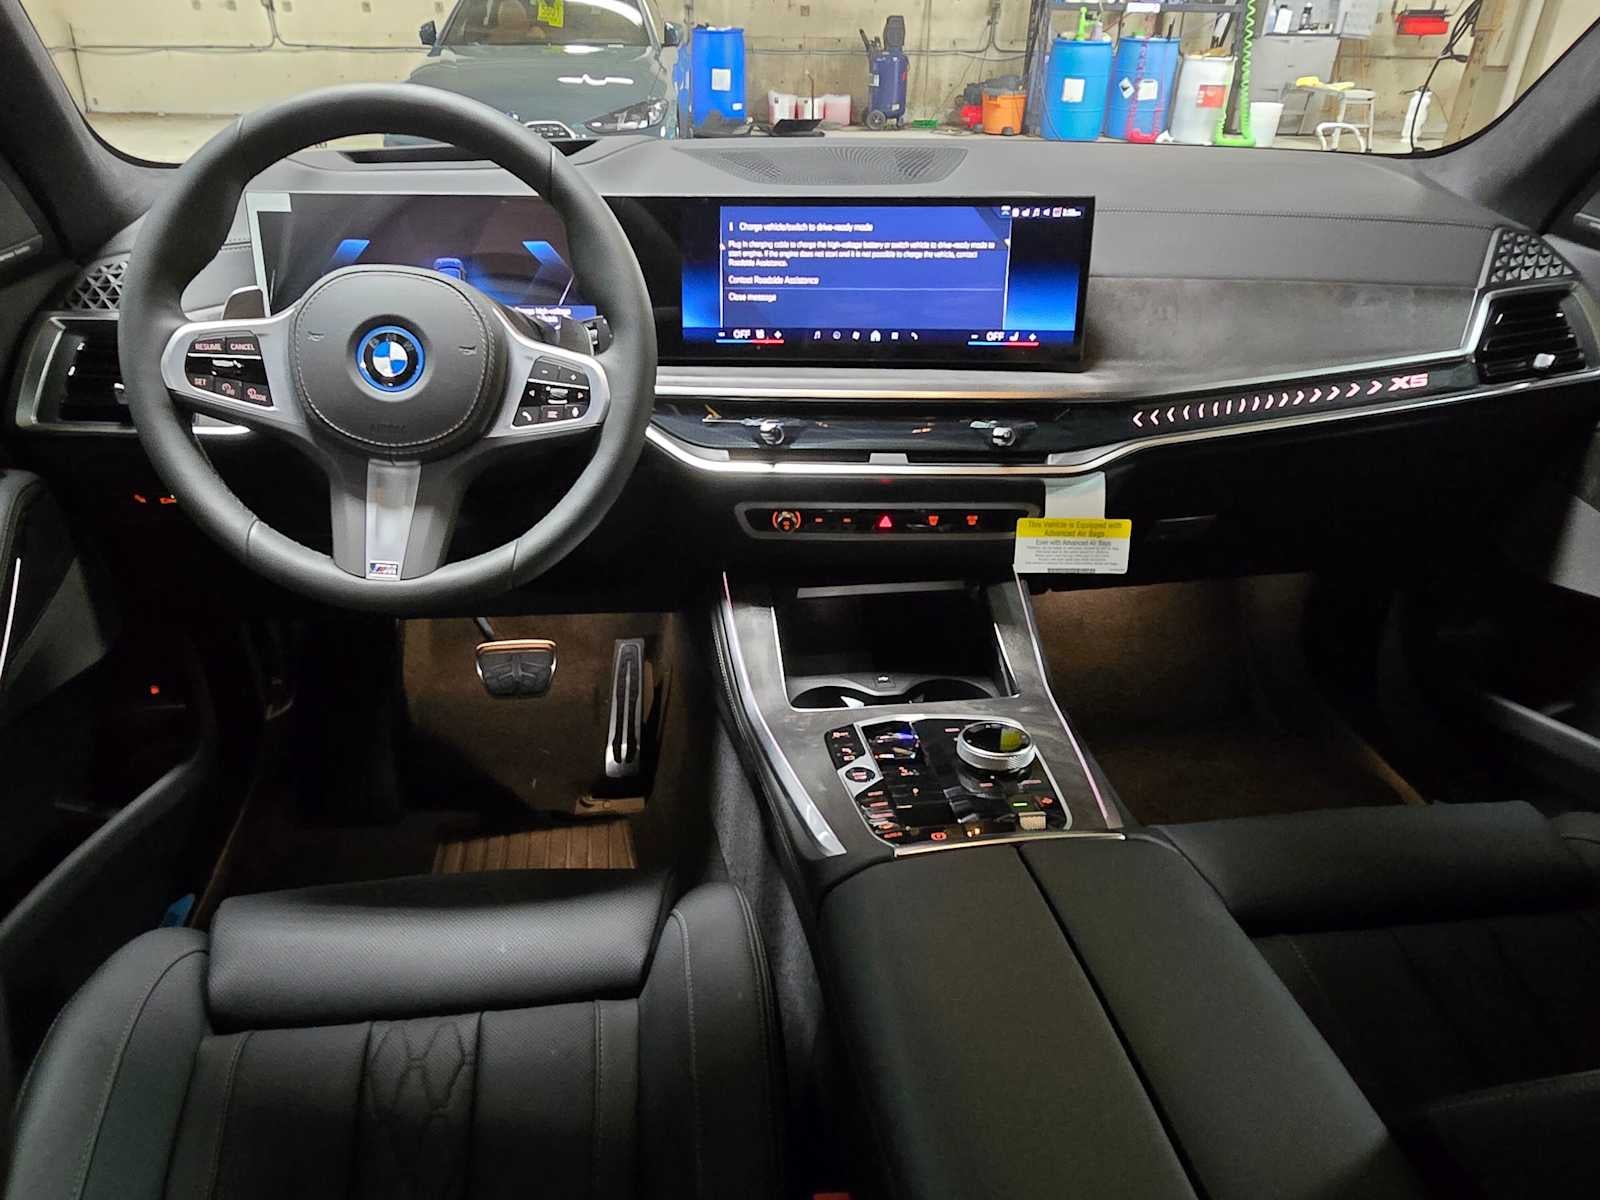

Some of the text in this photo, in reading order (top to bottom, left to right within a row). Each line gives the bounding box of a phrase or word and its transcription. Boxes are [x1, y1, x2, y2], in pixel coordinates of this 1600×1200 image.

[739, 222, 762, 232] Charge
[728, 276, 819, 285] Contact Roadside Assistance
[728, 292, 776, 302] Close message
[733, 330, 750, 338] OFF
[986, 331, 1004, 340] OFF
[1388, 373, 1428, 391] X5
